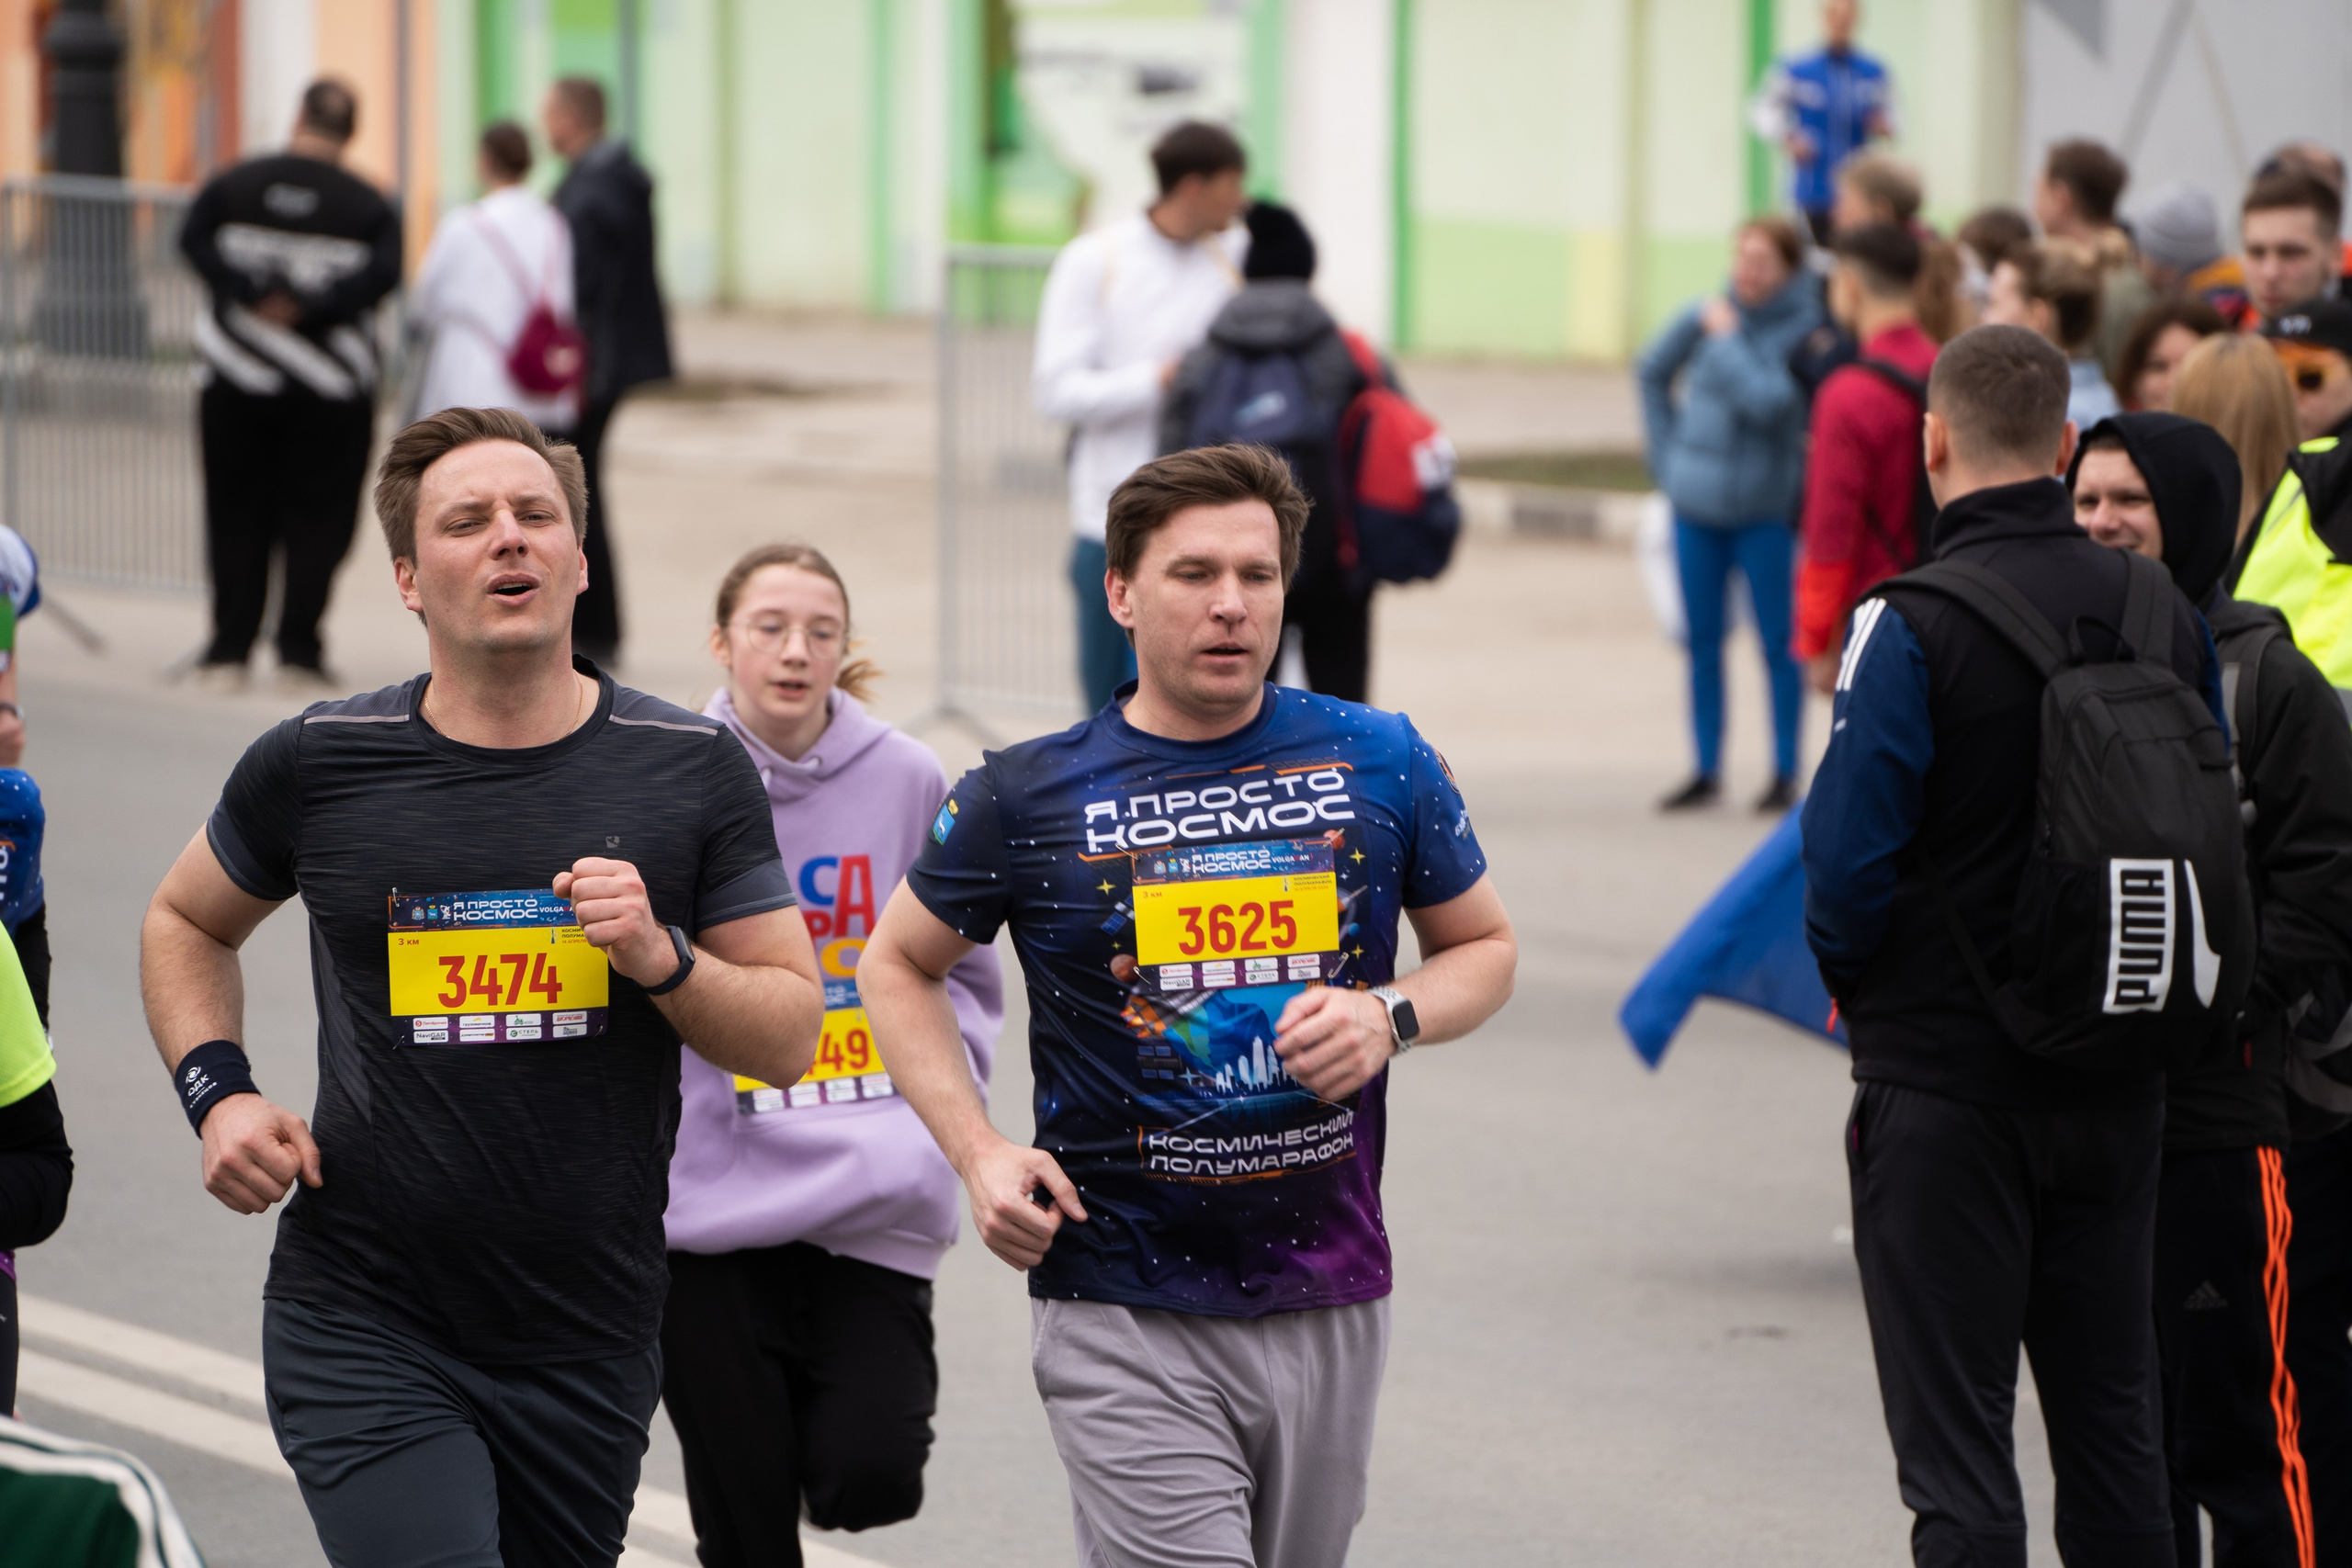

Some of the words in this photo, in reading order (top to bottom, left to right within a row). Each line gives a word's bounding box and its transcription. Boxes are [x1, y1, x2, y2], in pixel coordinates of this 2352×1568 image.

[1084, 799, 1118, 824] Я
[1129, 770, 1345, 818] ПРОСТО
[1085, 794, 1356, 853] КОСМОС
[1192, 853, 1202, 863] Я
[1205, 849, 1271, 863] ПРОСТО
[1193, 859, 1272, 874] КОСМОС
[453, 901, 464, 910] Я
[468, 899, 538, 910] ПРОСТО
[453, 908, 539, 921] КОСМОС
[398, 938, 404, 946] 3
[1178, 900, 1296, 955] 3625
[2112, 867, 2166, 1007] PUMA
[437, 953, 563, 1009] 3474
[187, 1074, 209, 1097] ОДК
[1148, 1107, 1355, 1155] КОСМИЧЕСКИЙ
[1150, 1132, 1355, 1175] ПОЛУМАРАФОН
